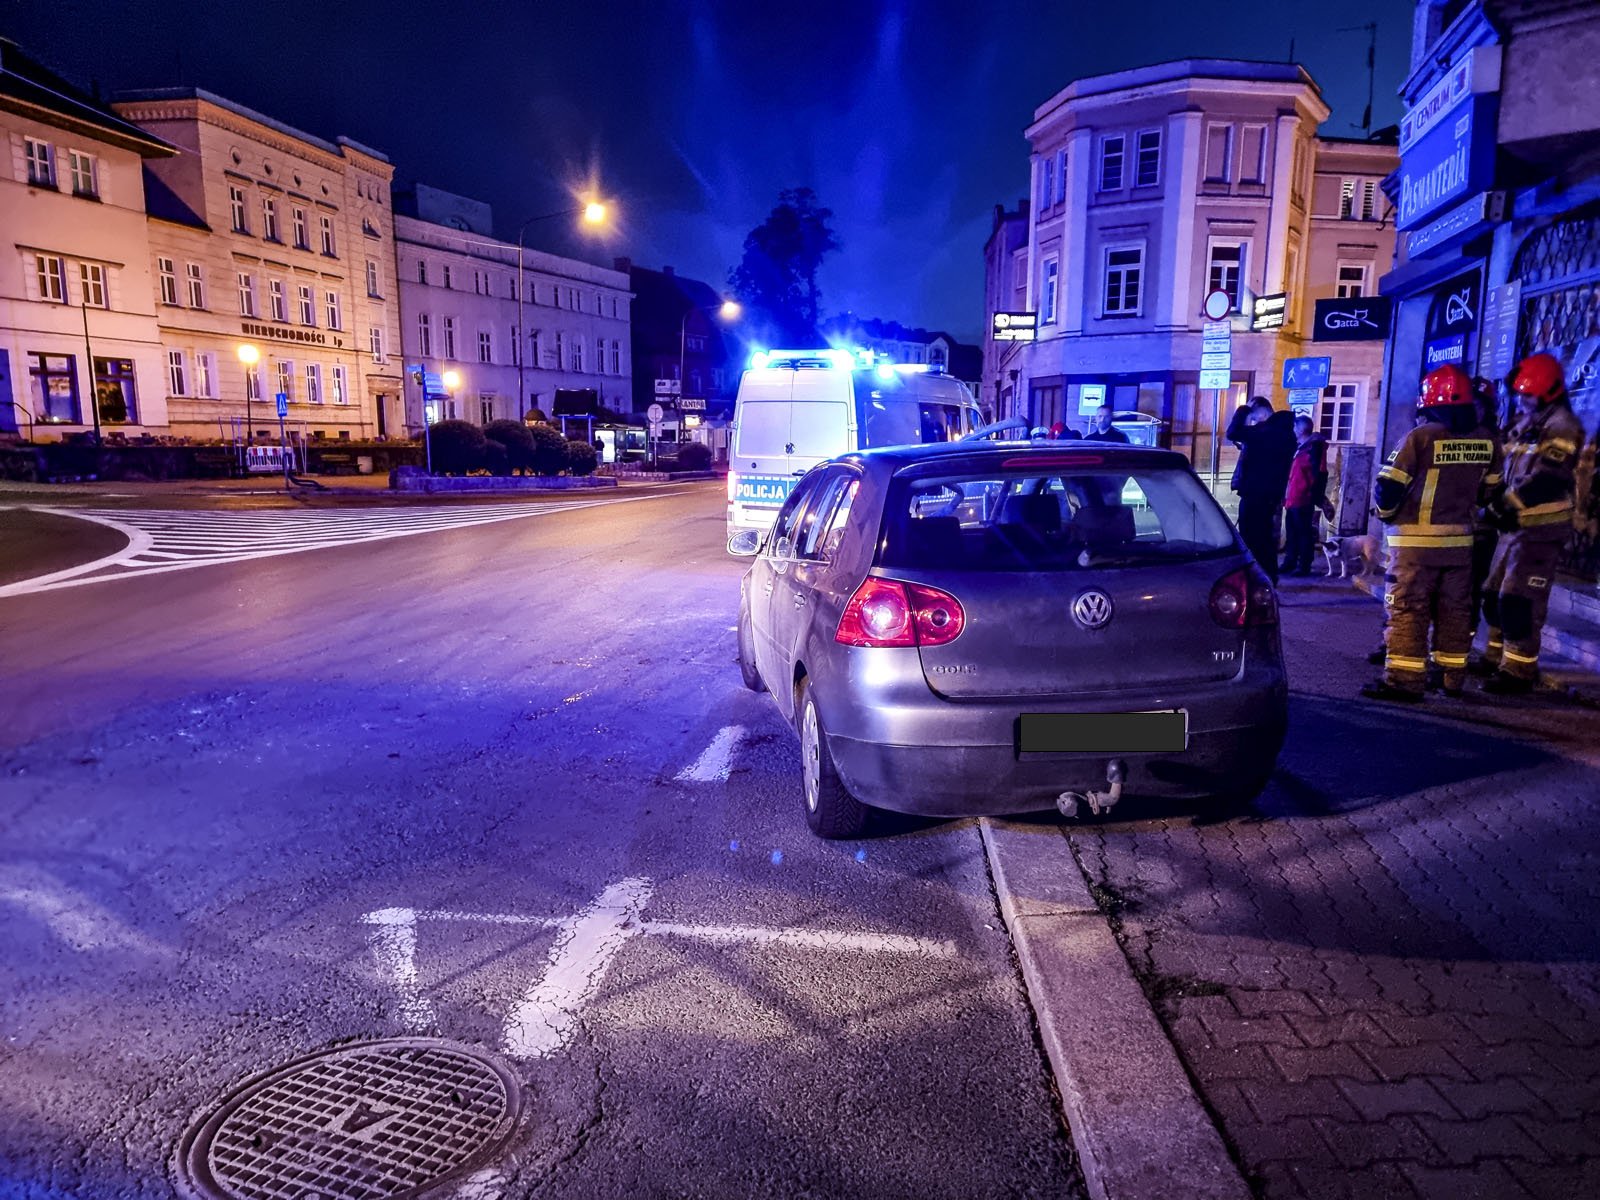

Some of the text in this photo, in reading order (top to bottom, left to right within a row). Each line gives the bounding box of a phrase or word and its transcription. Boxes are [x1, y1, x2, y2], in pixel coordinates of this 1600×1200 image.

[1416, 84, 1450, 130] CENTRUM
[1324, 310, 1361, 329] Gatta
[736, 483, 785, 500] POLICJA
